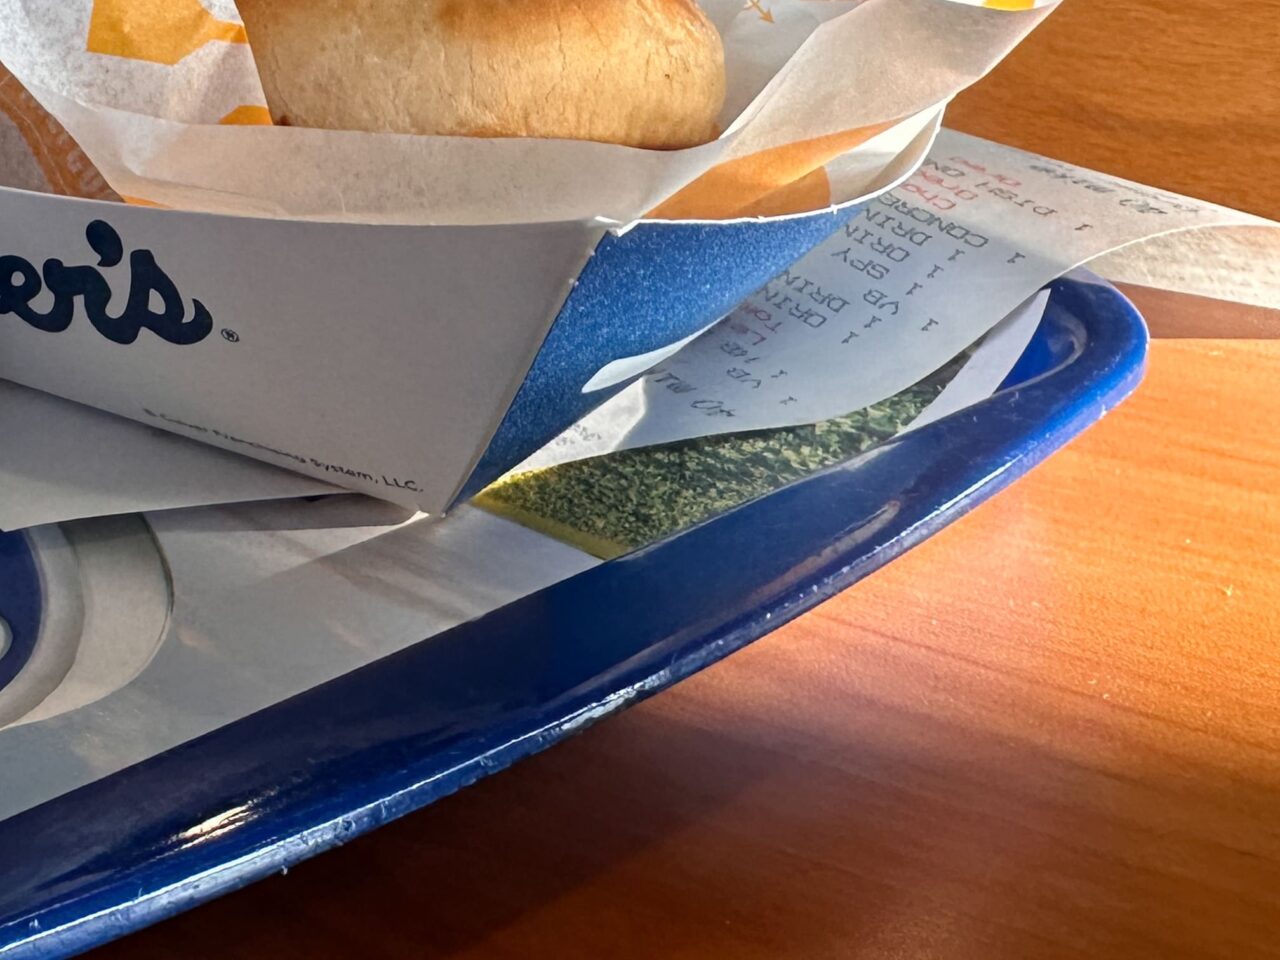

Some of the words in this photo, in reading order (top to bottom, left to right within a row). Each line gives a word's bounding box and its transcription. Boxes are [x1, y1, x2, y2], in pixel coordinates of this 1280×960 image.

[947, 248, 965, 262] 1
[1006, 251, 1025, 264] 1
[926, 264, 944, 279] 1
[905, 282, 923, 296] 1
[862, 288, 900, 316] VB
[863, 315, 882, 329] 1
[921, 318, 939, 332] 1
[841, 330, 859, 344] 1
[381, 474, 425, 494] LLC.
